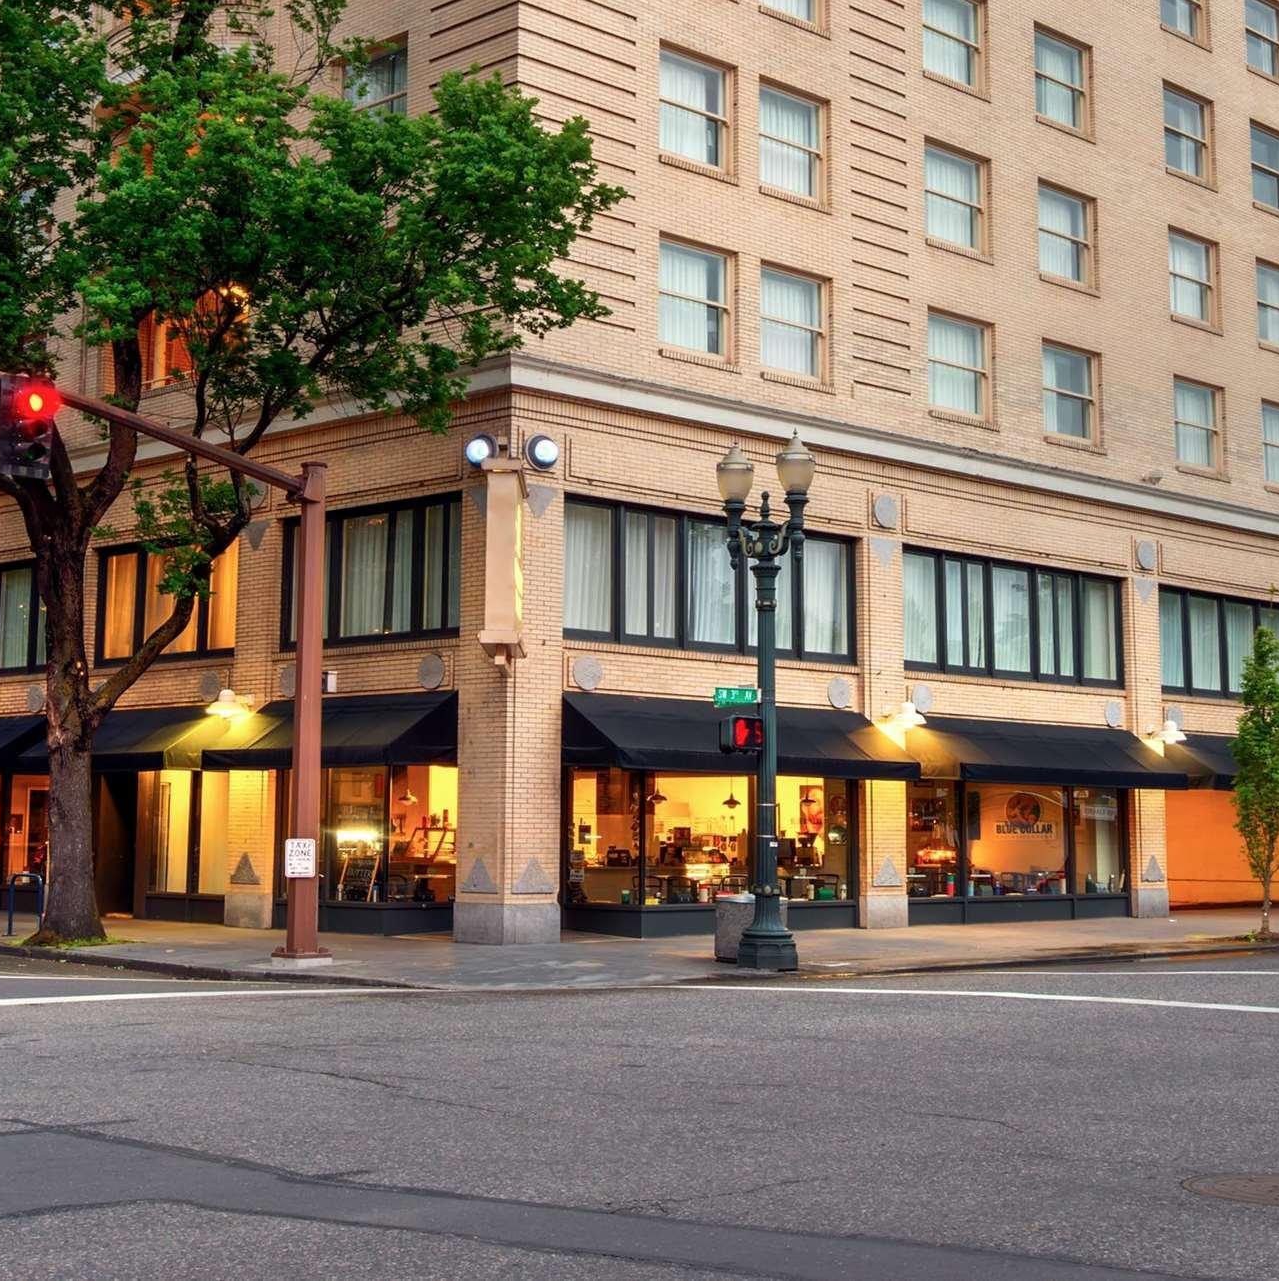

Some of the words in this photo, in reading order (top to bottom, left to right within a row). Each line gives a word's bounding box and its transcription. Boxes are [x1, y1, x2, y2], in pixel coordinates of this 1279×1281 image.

[996, 824, 1018, 834] BLUE
[1021, 824, 1053, 834] COLLAR
[289, 849, 312, 857] ZONE
